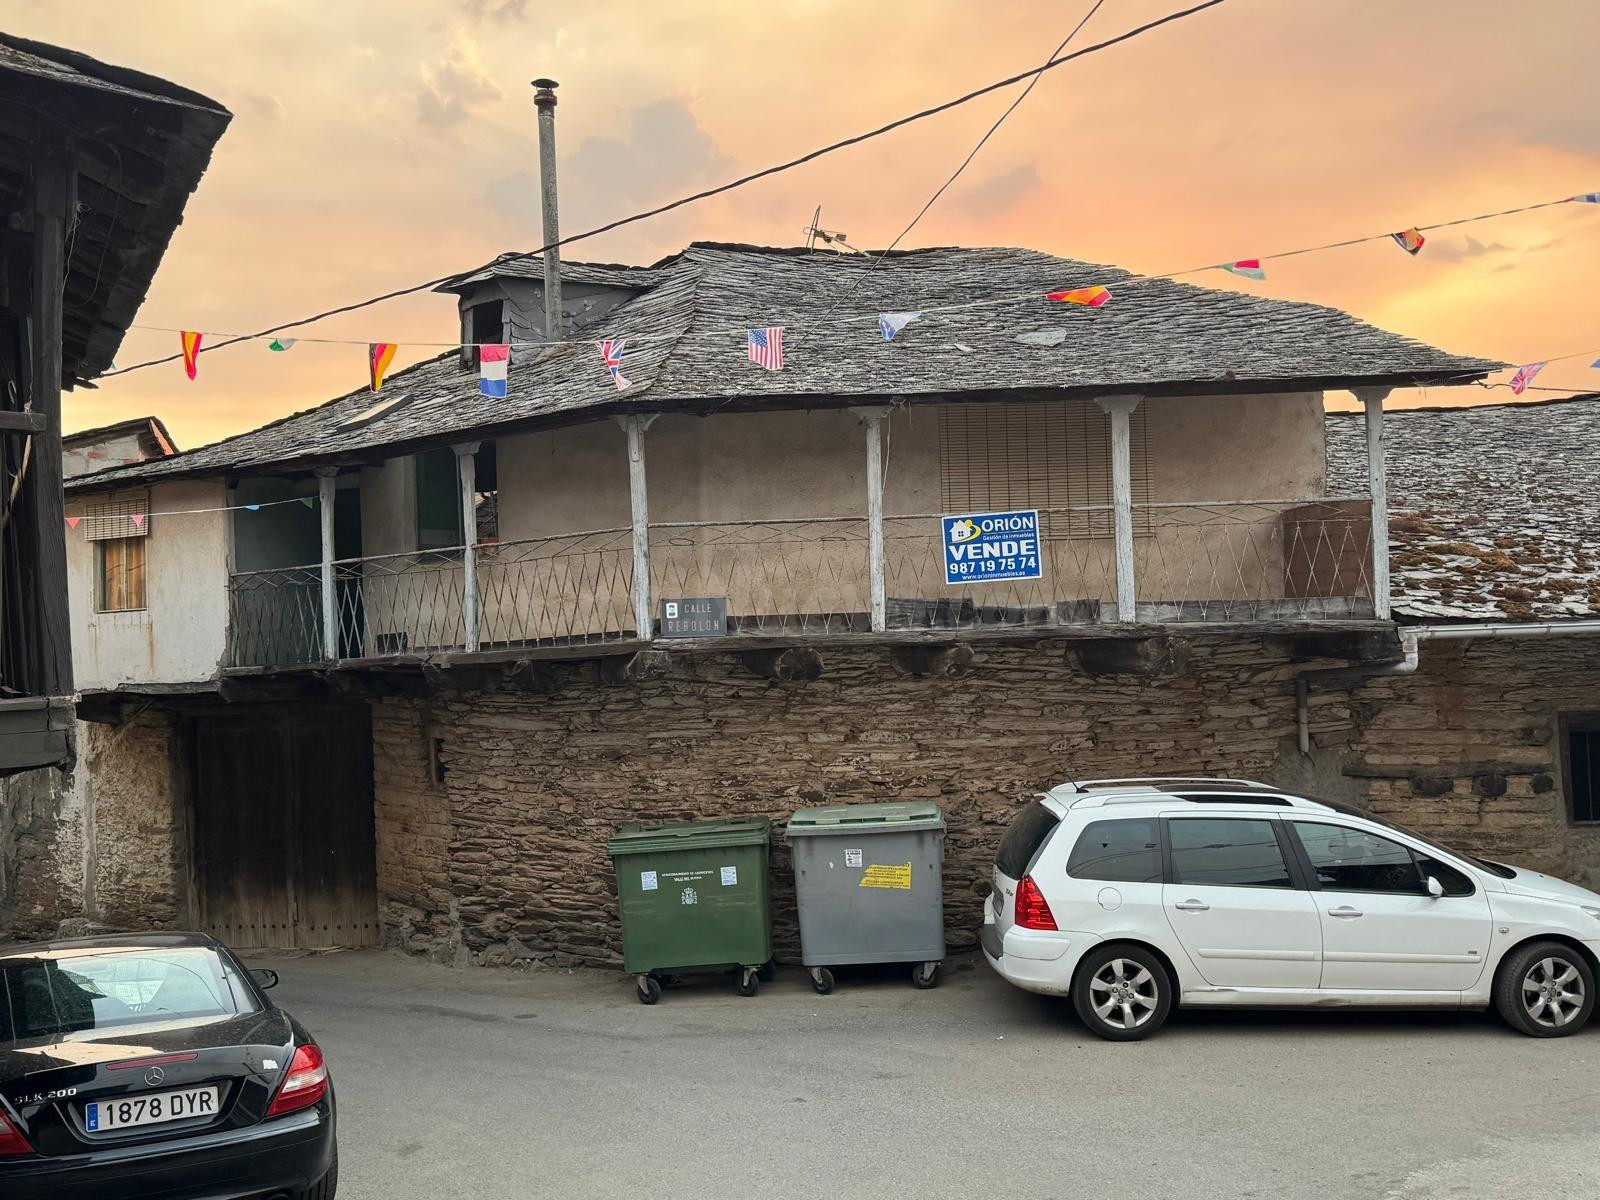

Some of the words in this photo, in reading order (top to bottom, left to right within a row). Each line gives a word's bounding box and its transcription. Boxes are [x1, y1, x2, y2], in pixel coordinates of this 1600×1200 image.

[981, 515, 1034, 531] ORIÓN
[948, 540, 1035, 560] VENDE
[949, 561, 976, 574] 987
[979, 560, 995, 571] 19
[998, 558, 1016, 571] 75
[1019, 556, 1037, 569] 74
[684, 604, 712, 613] CALLE
[14, 1093, 43, 1105] SLK
[47, 1087, 77, 1099] 200
[106, 1097, 162, 1126] 1878
[170, 1090, 213, 1117] DYR
